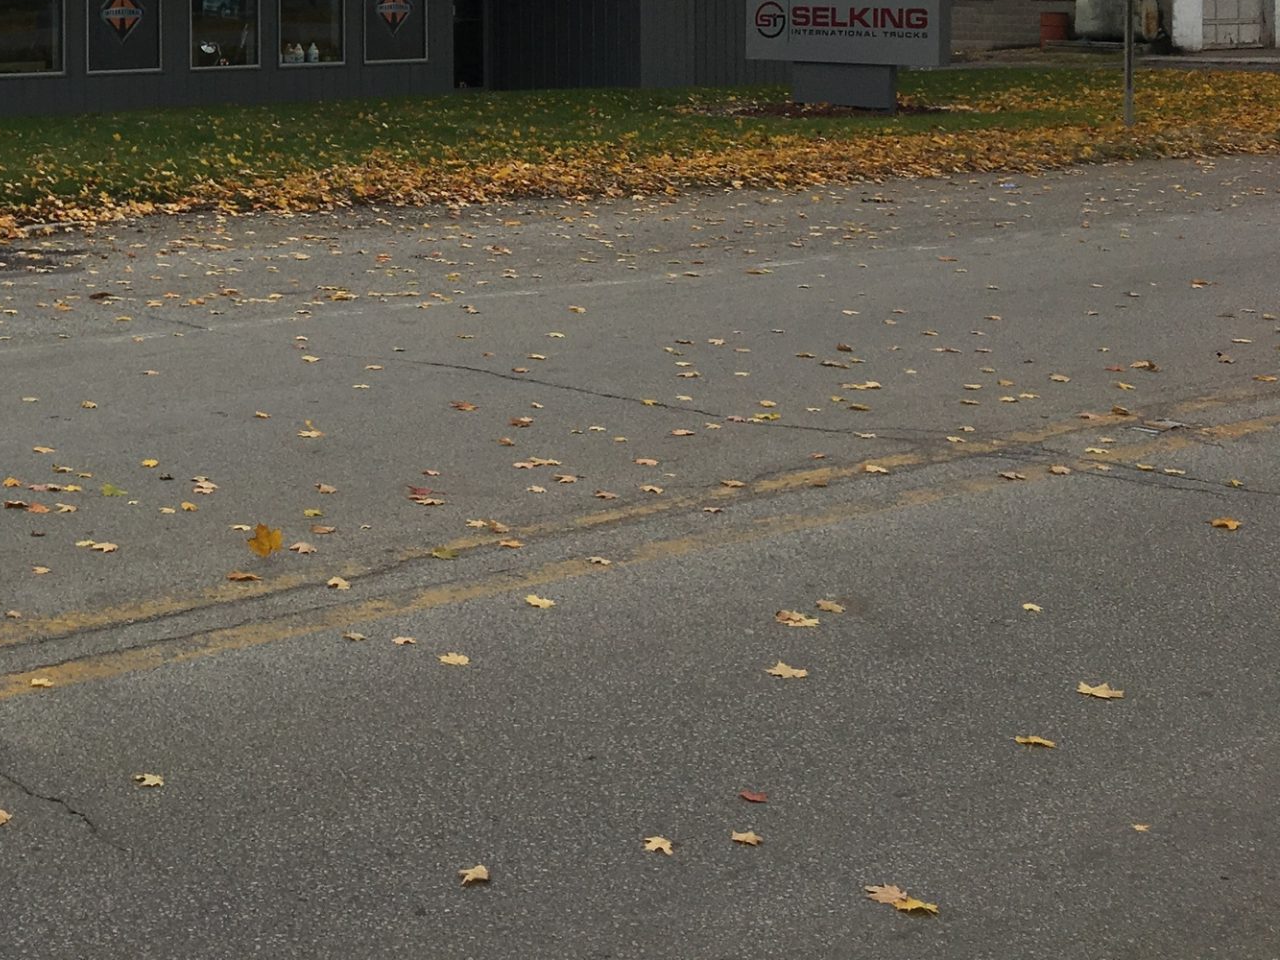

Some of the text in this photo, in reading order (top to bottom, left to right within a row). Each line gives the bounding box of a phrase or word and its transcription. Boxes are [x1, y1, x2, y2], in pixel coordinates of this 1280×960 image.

[791, 6, 928, 29] SELKING
[791, 28, 928, 39] INTERNATIONAL TRUCKS
